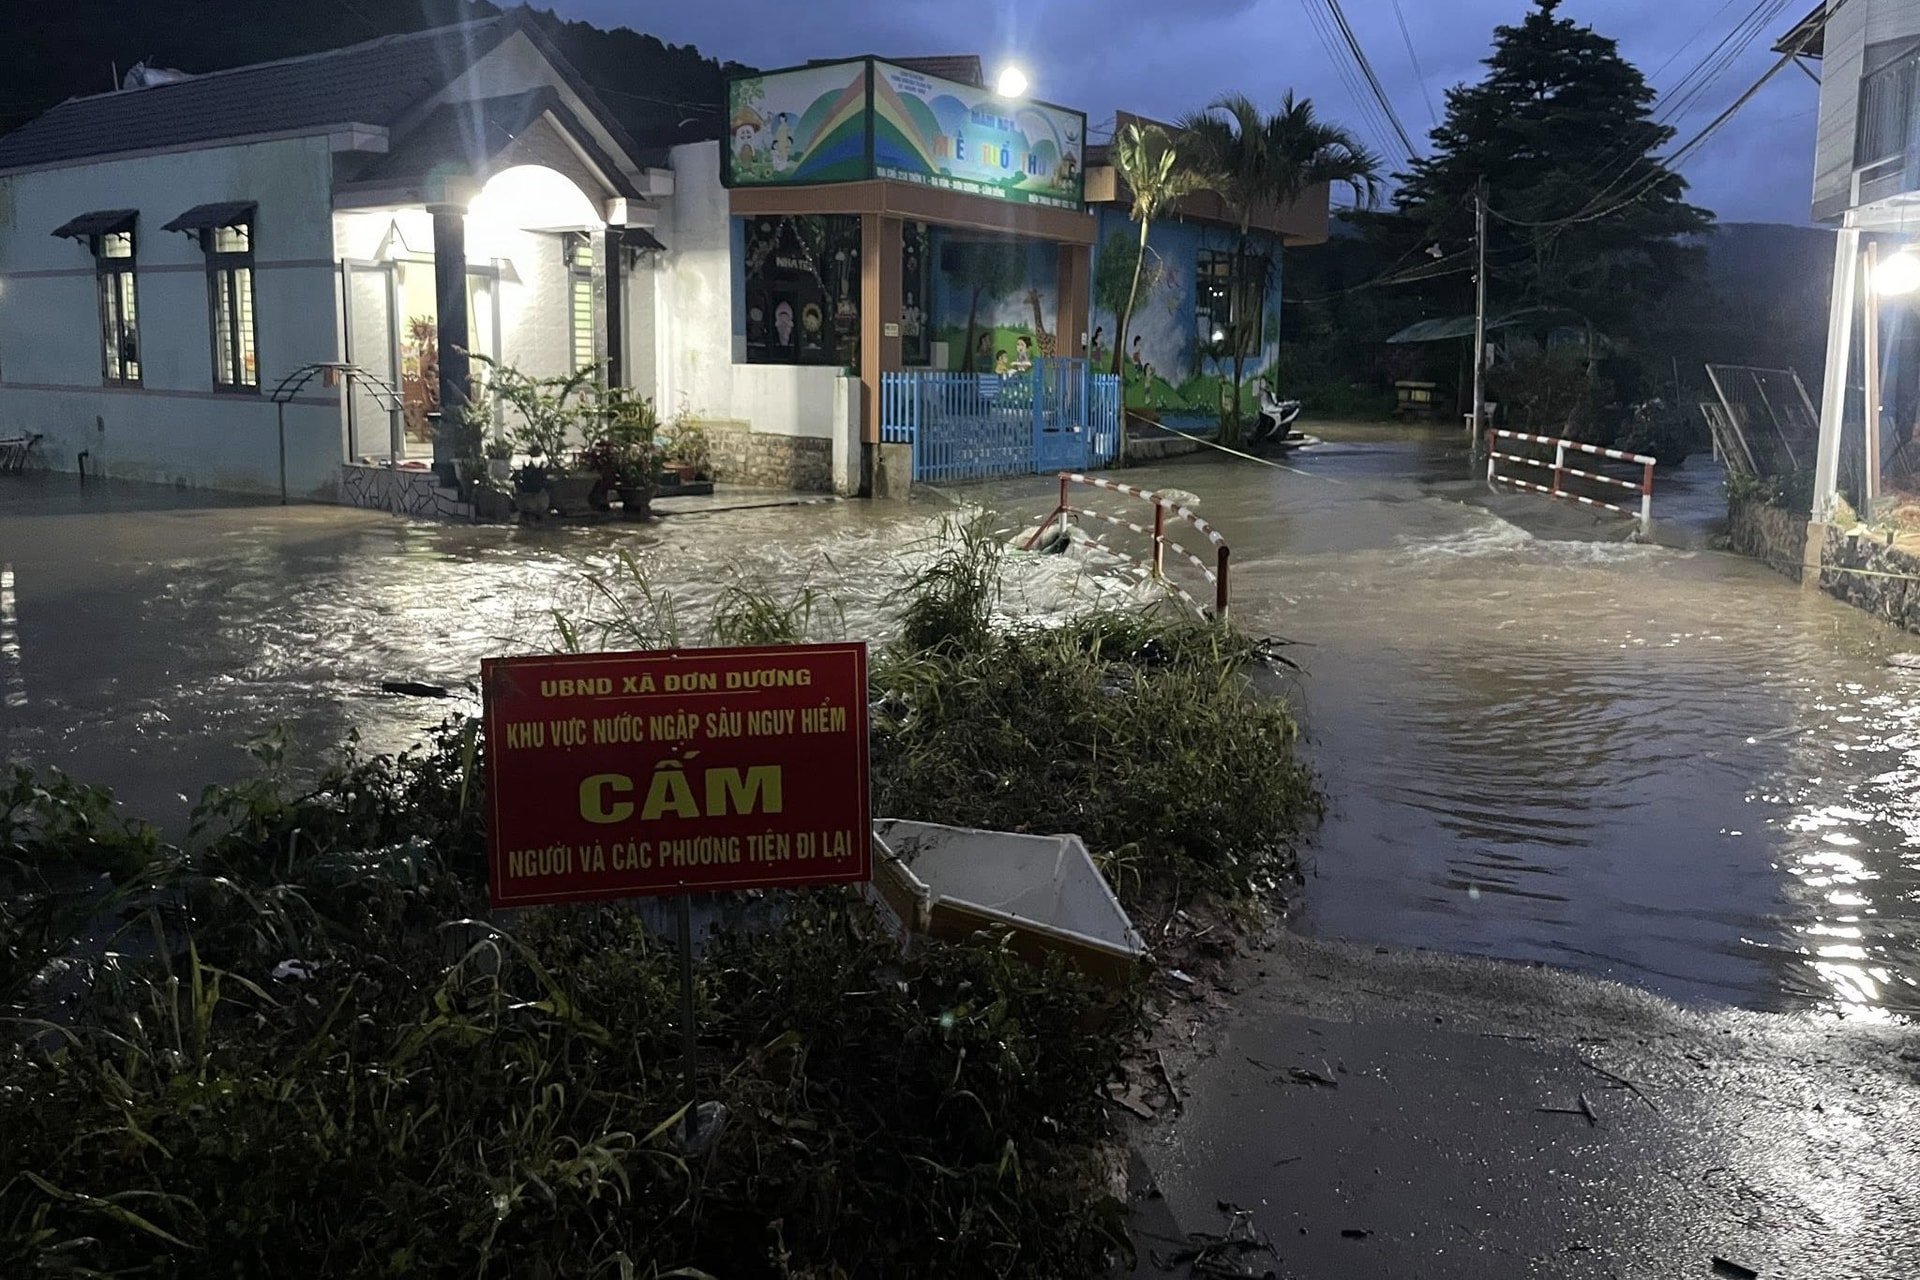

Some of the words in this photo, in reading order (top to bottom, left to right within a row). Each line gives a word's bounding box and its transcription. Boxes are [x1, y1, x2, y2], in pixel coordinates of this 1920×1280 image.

[932, 129, 973, 160] MIỀ
[982, 140, 1014, 169] TUỔ
[541, 678, 612, 697] UBND
[622, 672, 656, 693] XÃ
[664, 671, 717, 692] ĐƠN
[726, 668, 812, 689] DƯƠNG
[506, 721, 544, 749] KHU
[551, 717, 586, 752] VỰC
[593, 712, 643, 744] NƯỚC
[650, 709, 699, 745] NGẬP
[706, 706, 742, 738] SÂU
[748, 710, 794, 735] NGUY
[801, 697, 846, 733] HIỂM
[579, 750, 782, 824] CẤM
[509, 843, 572, 878] NGƯỜI
[579, 839, 605, 871] VÀ
[613, 837, 651, 870] CÁC
[659, 836, 740, 867] PHƯƠNG
[746, 829, 789, 867] TIỆN
[796, 831, 815, 859] ĐI
[823, 830, 851, 863] LẠI
